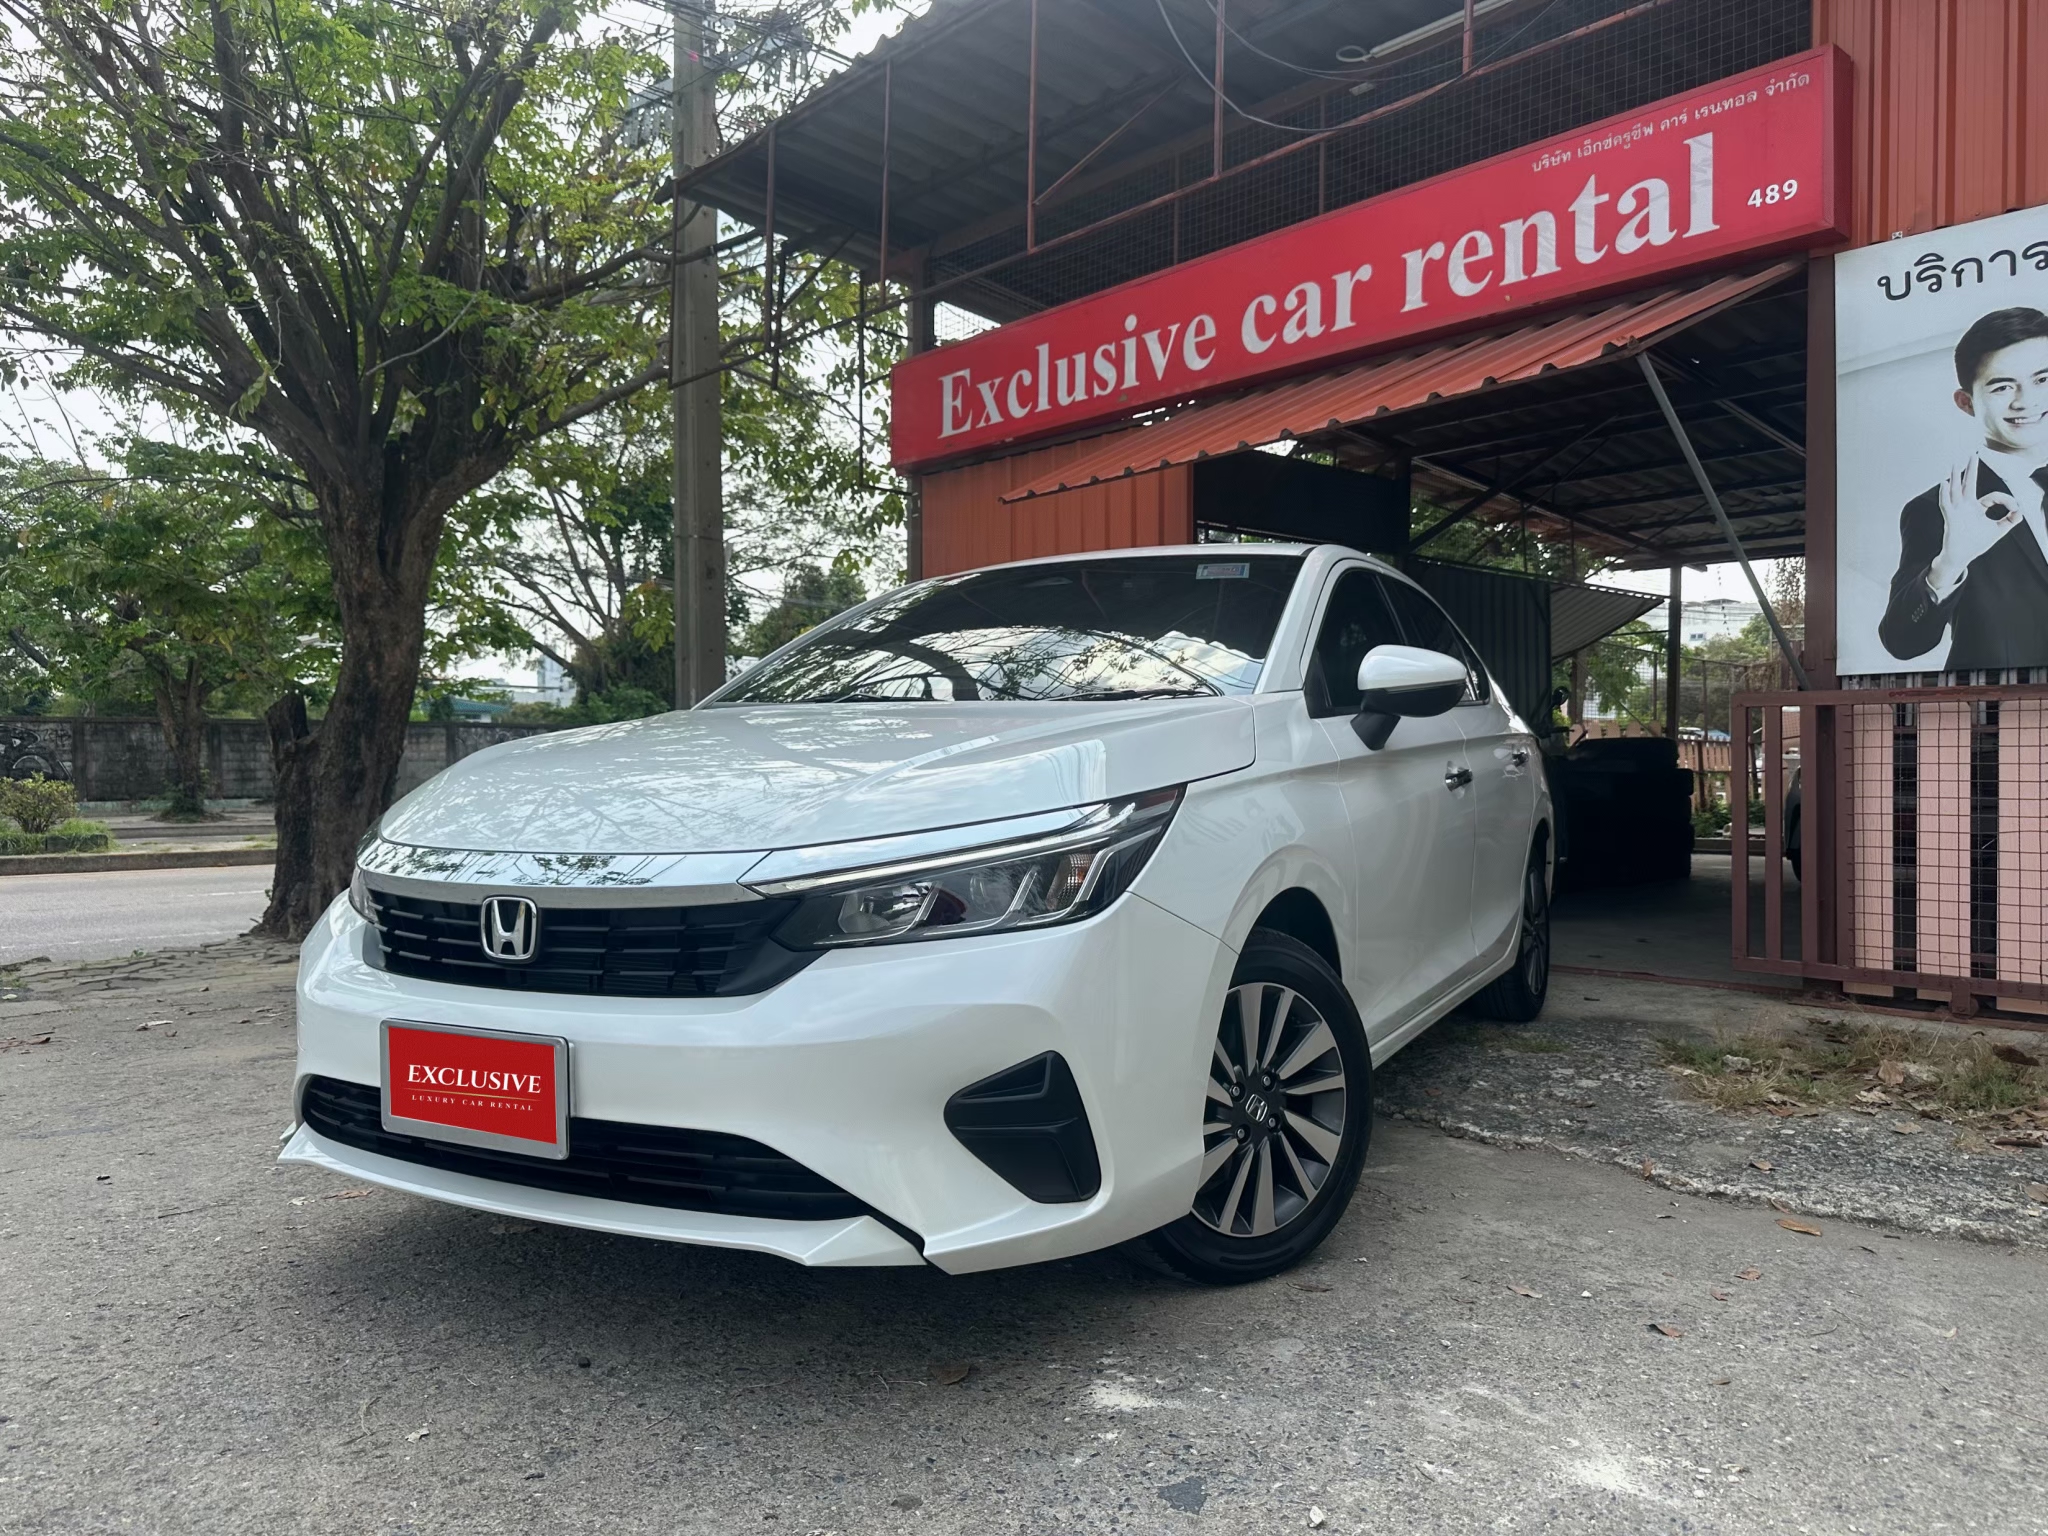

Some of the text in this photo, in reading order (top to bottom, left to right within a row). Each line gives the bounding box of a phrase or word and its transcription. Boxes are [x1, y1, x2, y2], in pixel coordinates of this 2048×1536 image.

[1531, 149, 1571, 172] บริษัท
[1660, 108, 1688, 132] คาร์
[1695, 90, 1758, 120] เรนทอล
[1765, 72, 1810, 97] จำกัด
[1746, 179, 1799, 209] 489
[938, 132, 1721, 440] Exclusive car rental
[407, 1064, 542, 1094] EXCLUSIVE
[411, 1094, 534, 1111] LUXURY CAR RENTAL
